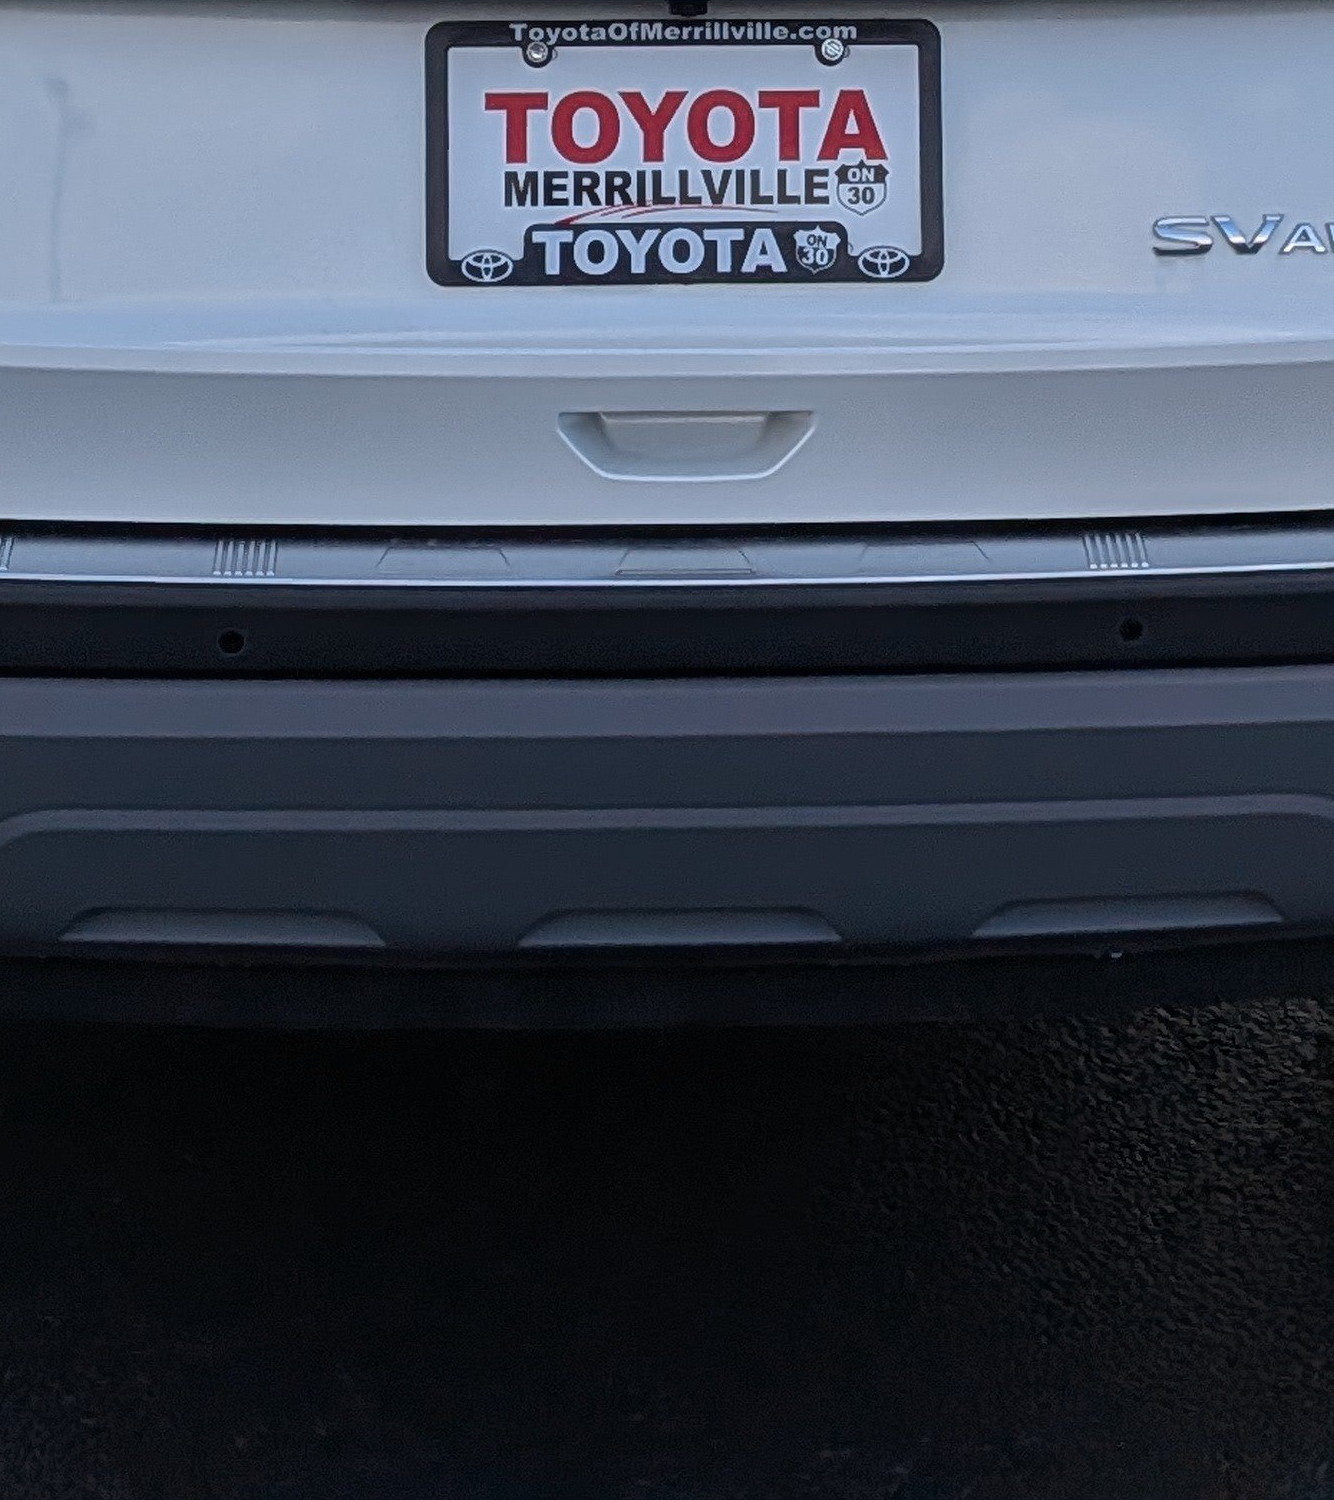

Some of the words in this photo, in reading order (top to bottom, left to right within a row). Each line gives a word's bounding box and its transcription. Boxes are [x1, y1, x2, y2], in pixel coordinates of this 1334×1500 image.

[509, 21, 858, 43] ToyotaOfMerrillville.com
[484, 89, 888, 163] TOYOTA
[847, 167, 875, 182] ON
[504, 167, 830, 207] MERRILLVILLE
[847, 186, 875, 205] 30
[806, 233, 828, 247] ON
[1152, 213, 1284, 256] SV
[532, 228, 787, 276] TOYOTA
[802, 247, 829, 266] 30
